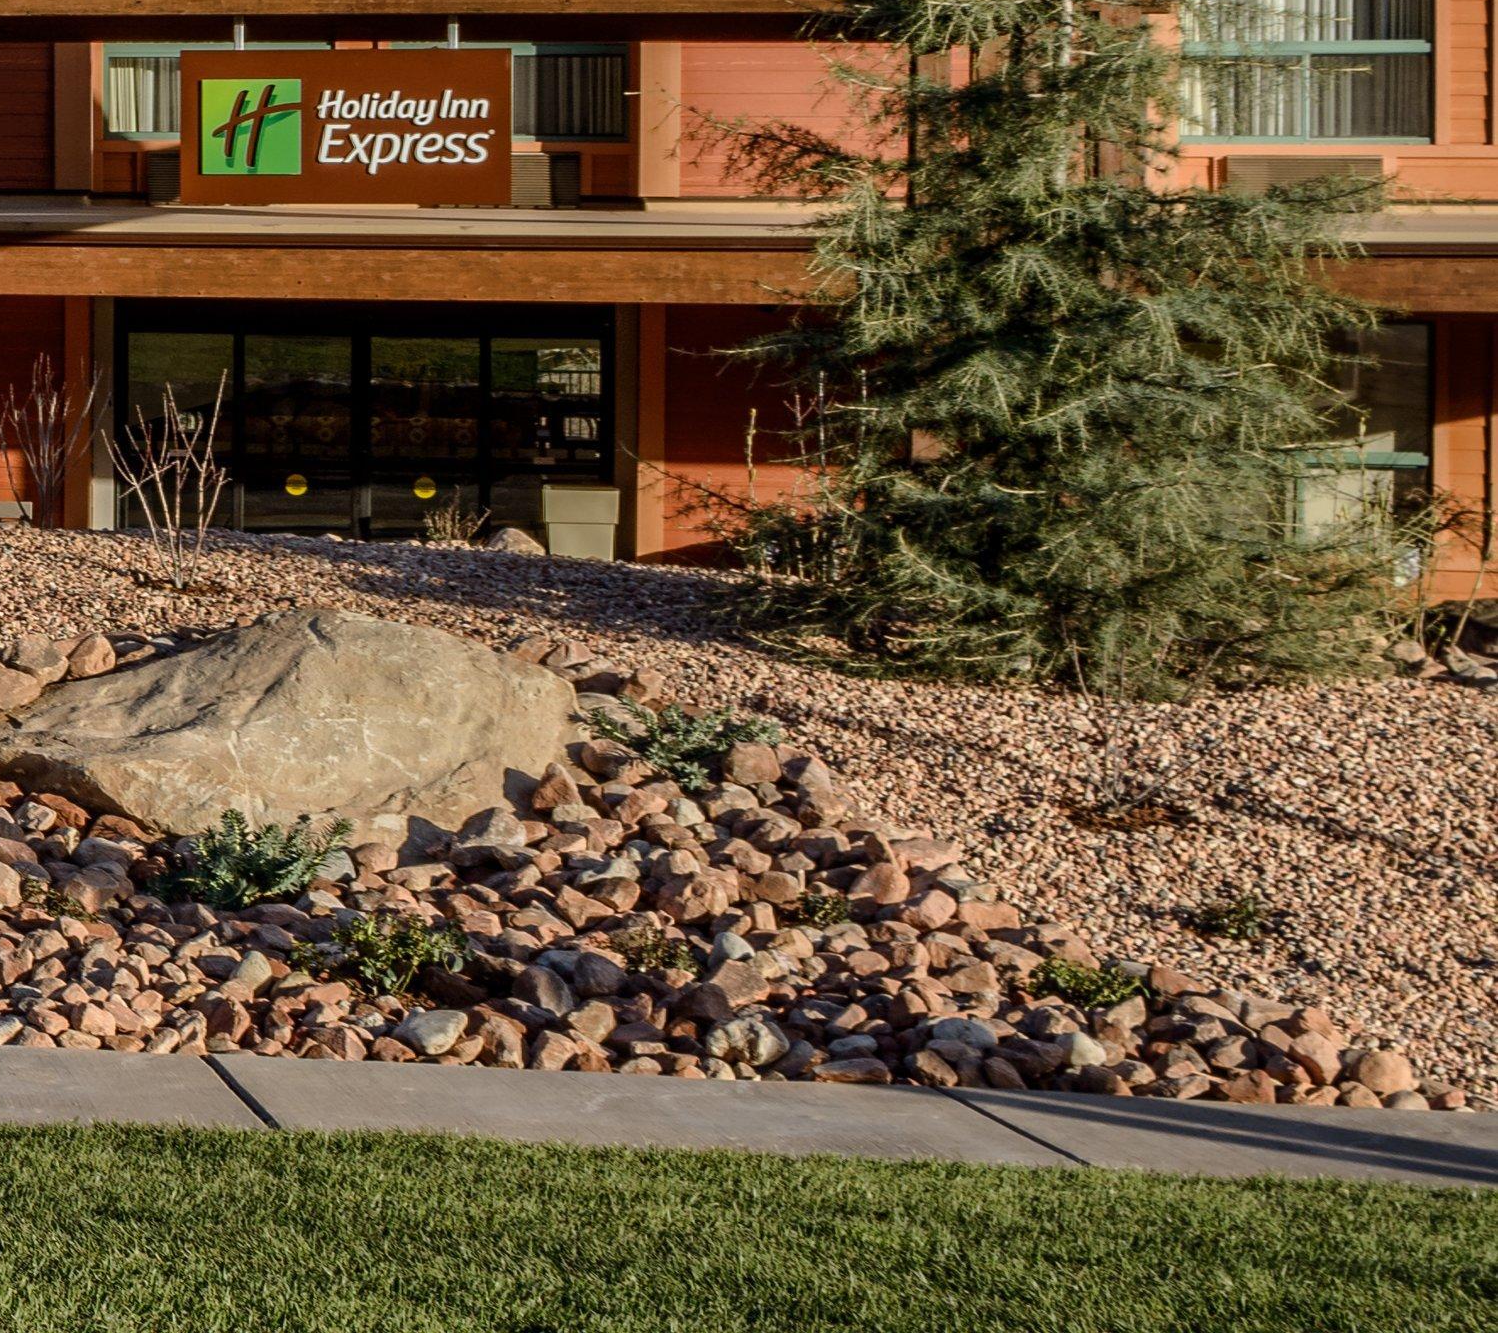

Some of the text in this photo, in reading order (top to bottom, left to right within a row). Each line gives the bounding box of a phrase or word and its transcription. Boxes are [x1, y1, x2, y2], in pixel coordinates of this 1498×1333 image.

[316, 88, 490, 126] Holiday Inn
[317, 123, 491, 175] Express
